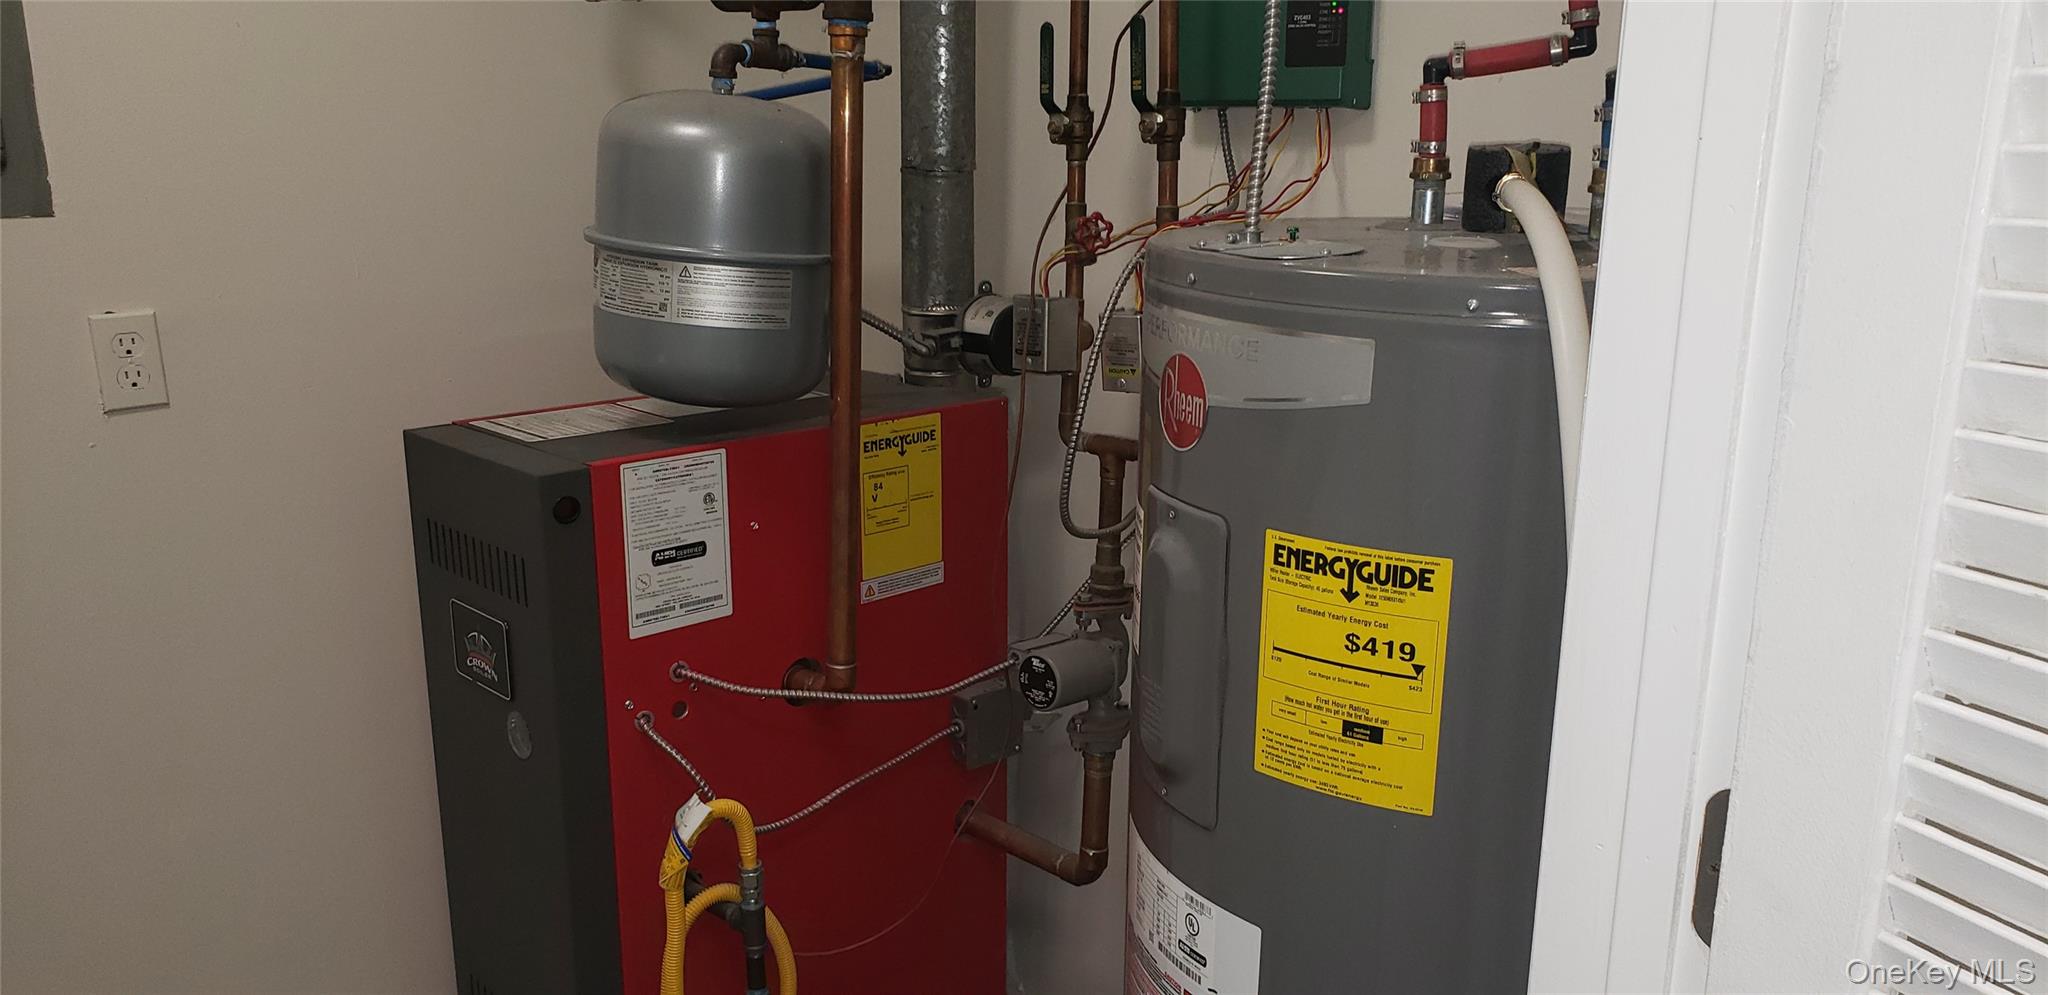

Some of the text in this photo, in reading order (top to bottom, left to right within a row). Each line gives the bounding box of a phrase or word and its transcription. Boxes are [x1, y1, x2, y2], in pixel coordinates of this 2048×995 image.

[1164, 355, 1203, 433] Rheem
[864, 429, 936, 453] ENERGYGUIDE
[874, 482, 884, 492] 84
[1274, 543, 1435, 592] ENERGYGUIDE
[1296, 604, 1388, 629] Estimated Yearly Energy Cost
[1344, 632, 1416, 662] $419
[467, 657, 498, 682] CROWN
[1316, 696, 1370, 716] First Hour Rating
